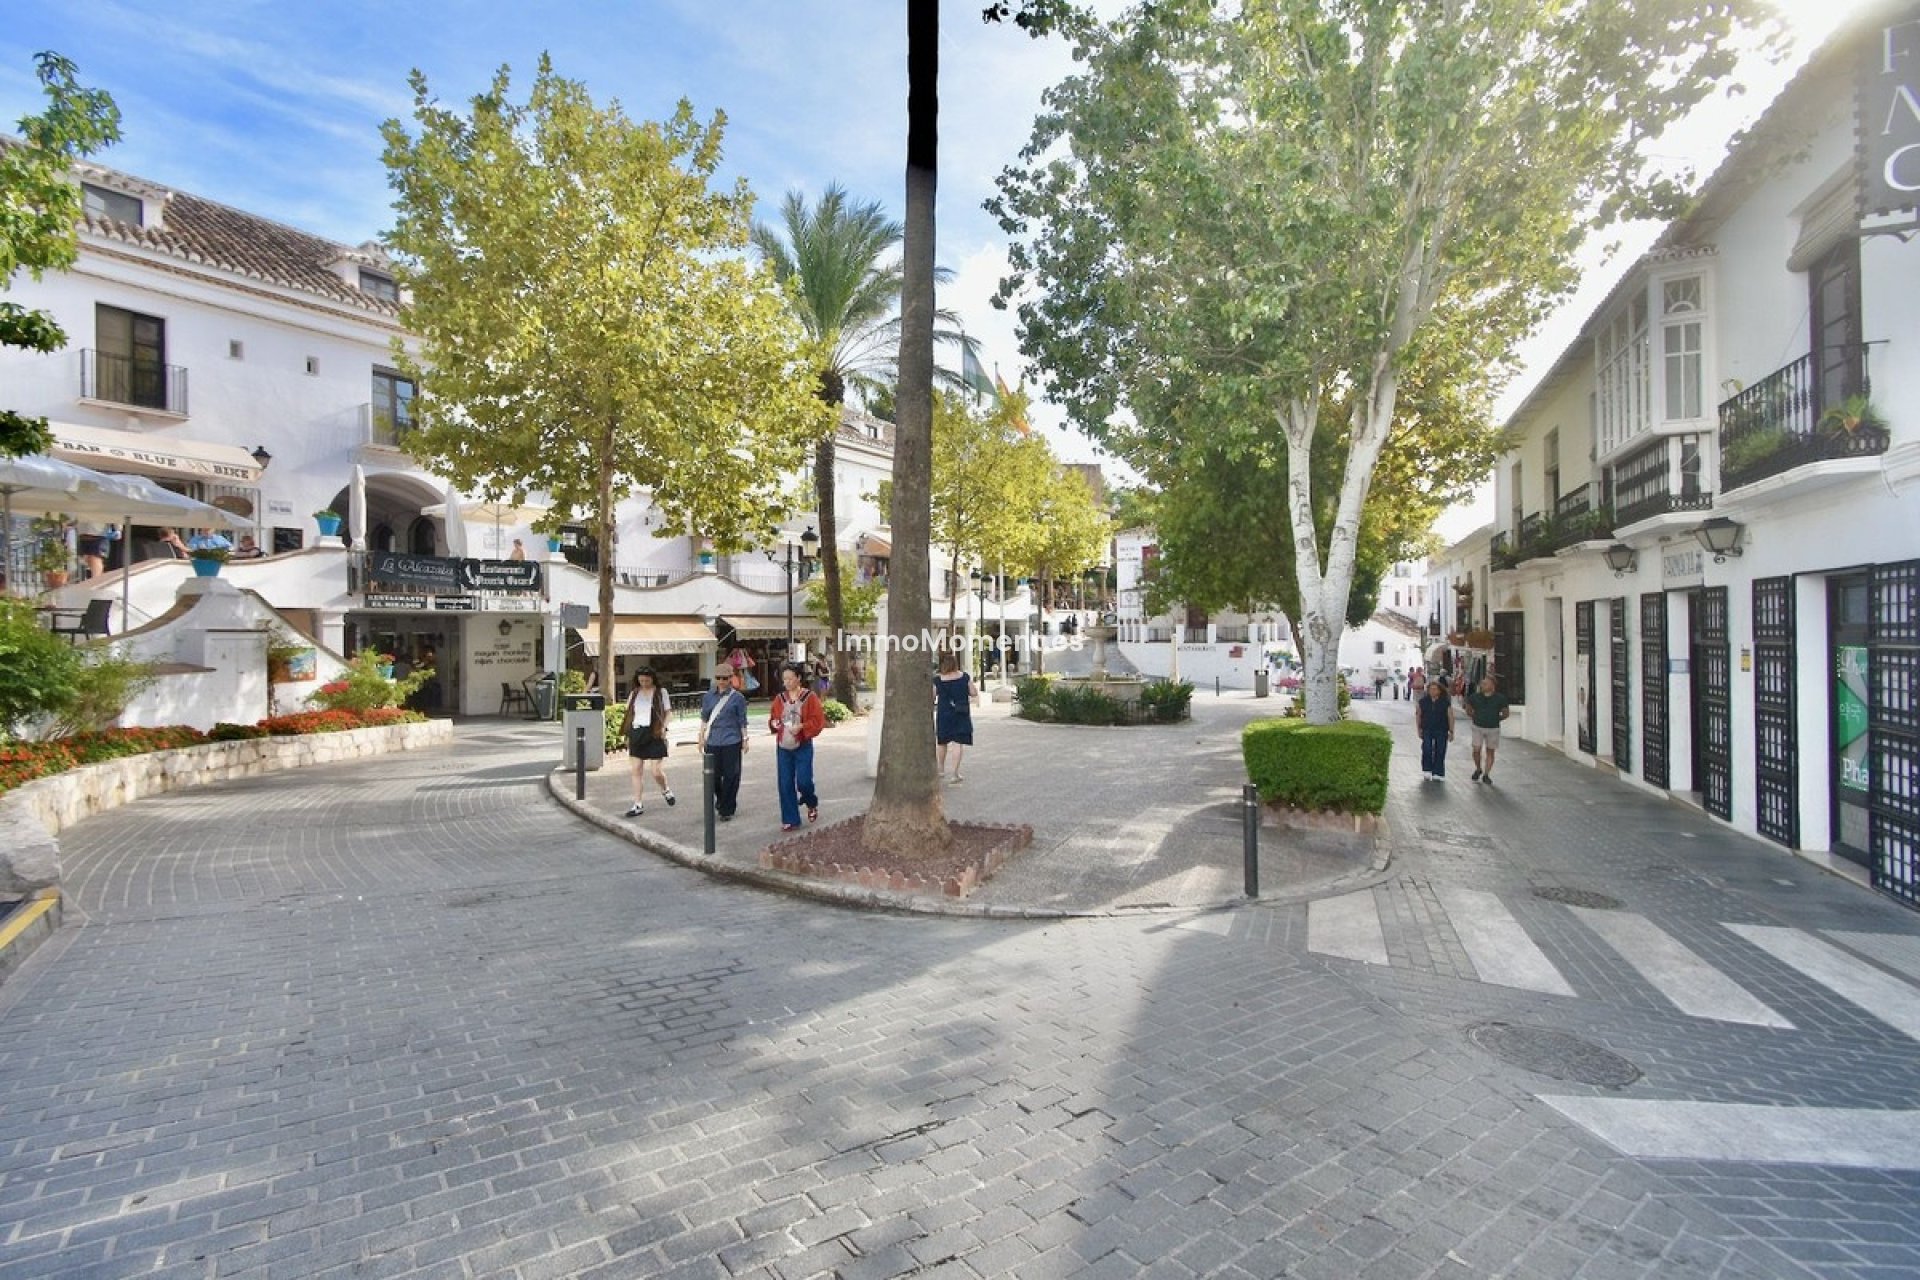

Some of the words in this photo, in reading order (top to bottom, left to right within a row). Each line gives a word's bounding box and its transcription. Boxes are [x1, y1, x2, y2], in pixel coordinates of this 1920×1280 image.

[63, 442, 101, 453] BAR
[132, 452, 177, 467] BLUE
[213, 464, 250, 479] BIKE
[367, 594, 426, 602] RESTAURANTE
